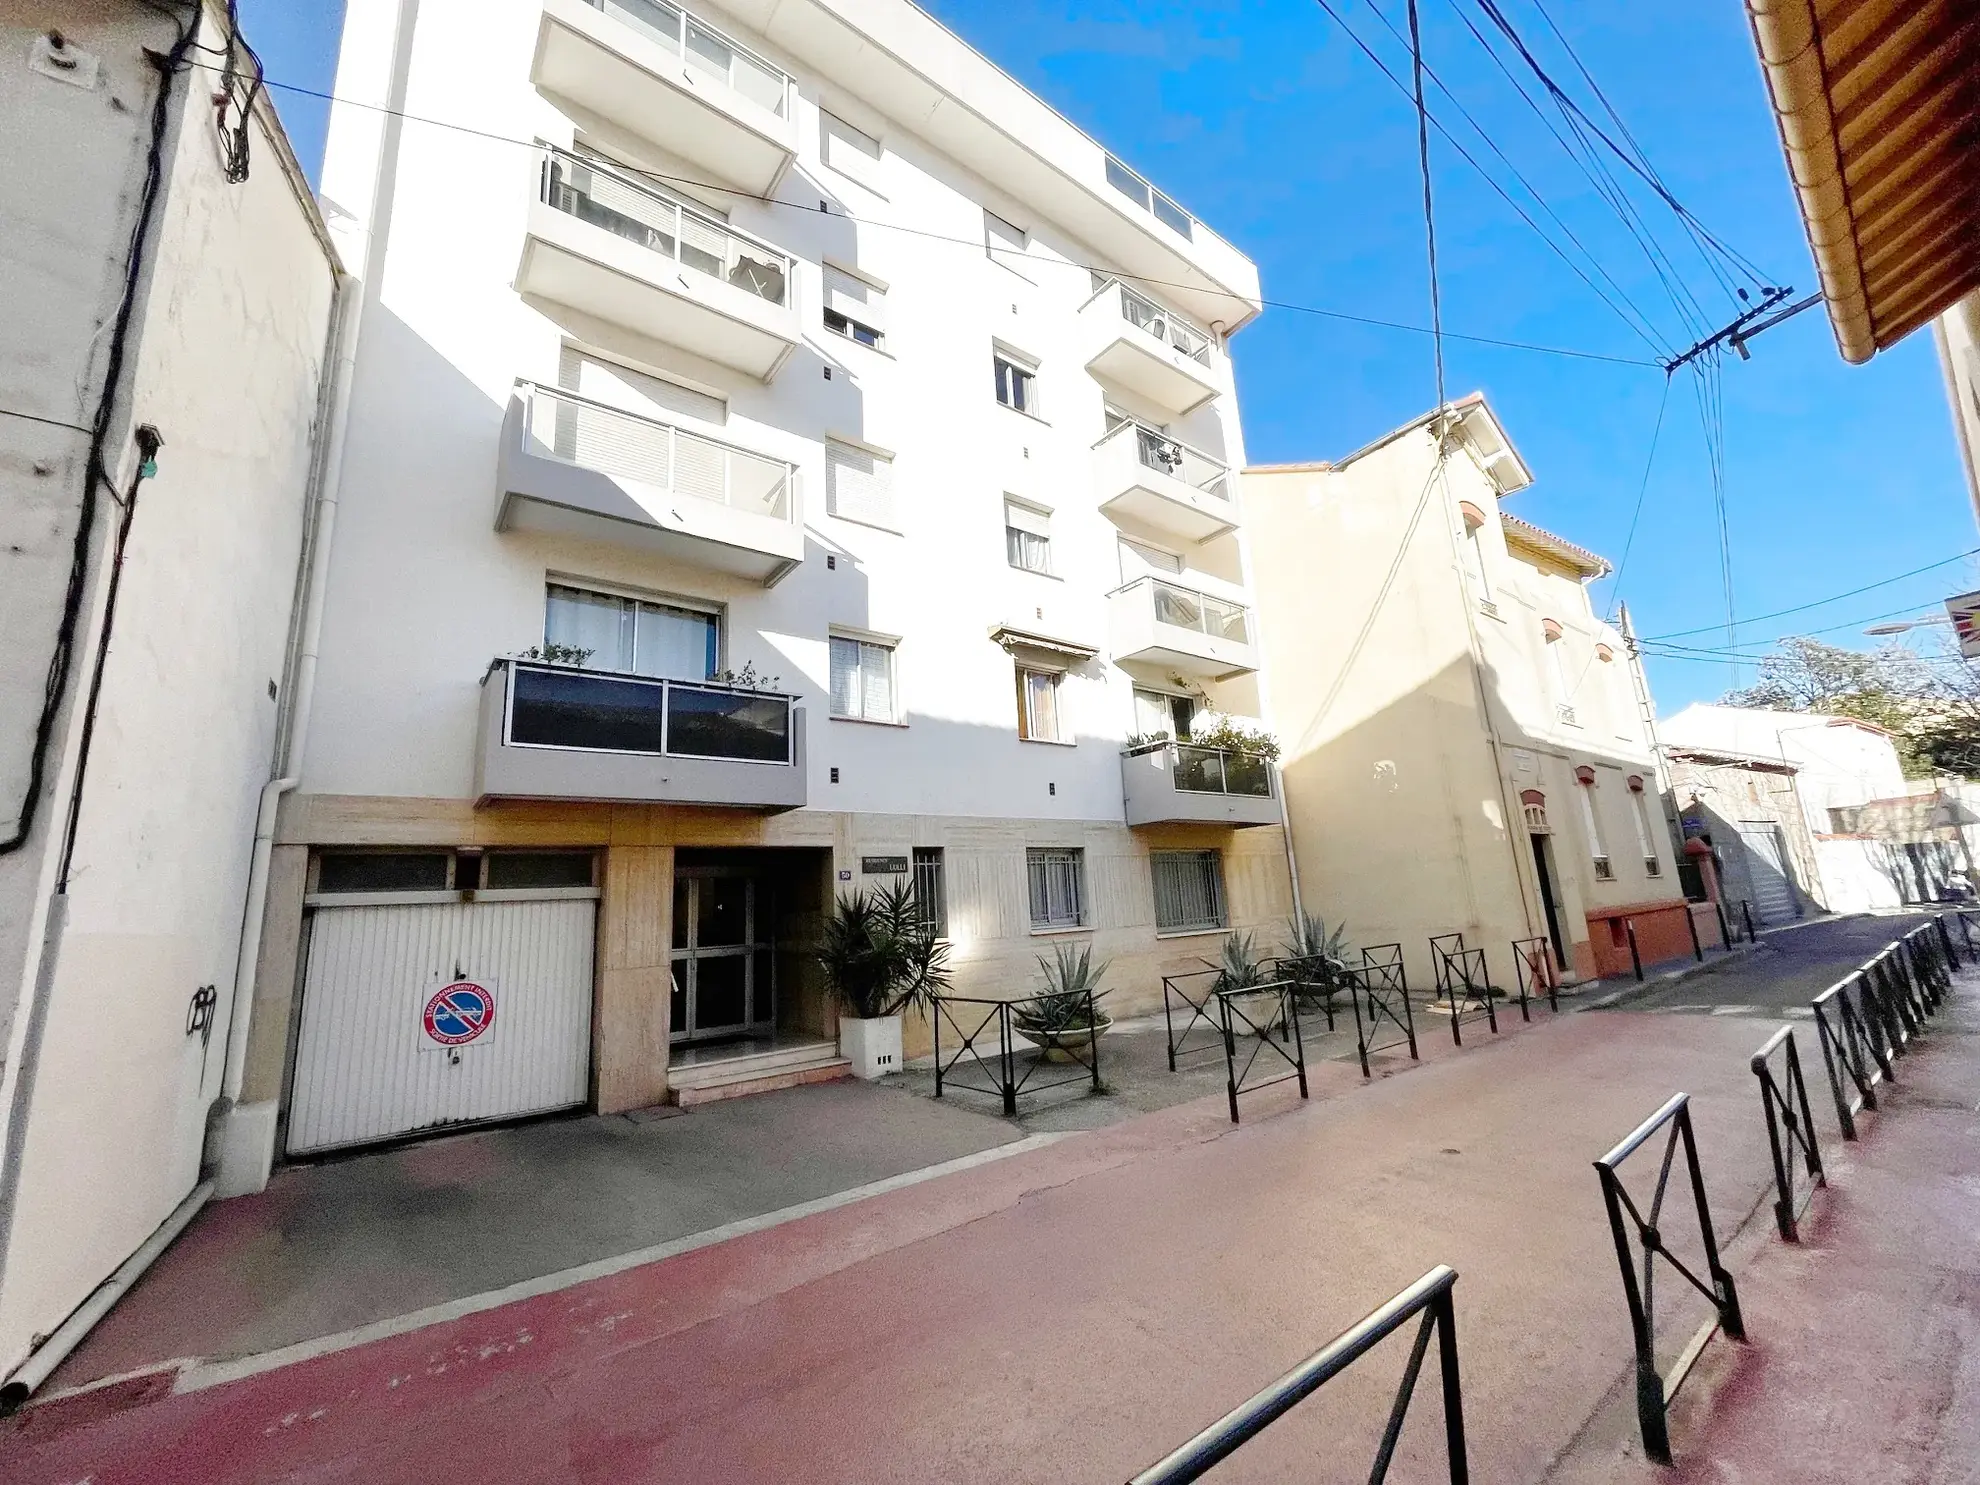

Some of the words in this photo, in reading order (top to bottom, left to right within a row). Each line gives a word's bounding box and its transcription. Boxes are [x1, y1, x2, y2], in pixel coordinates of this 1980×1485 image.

[426, 984, 475, 1017] STATIONNEMENT
[475, 987, 492, 1011] INTERDIT
[429, 1028, 448, 1042] SORTIE
